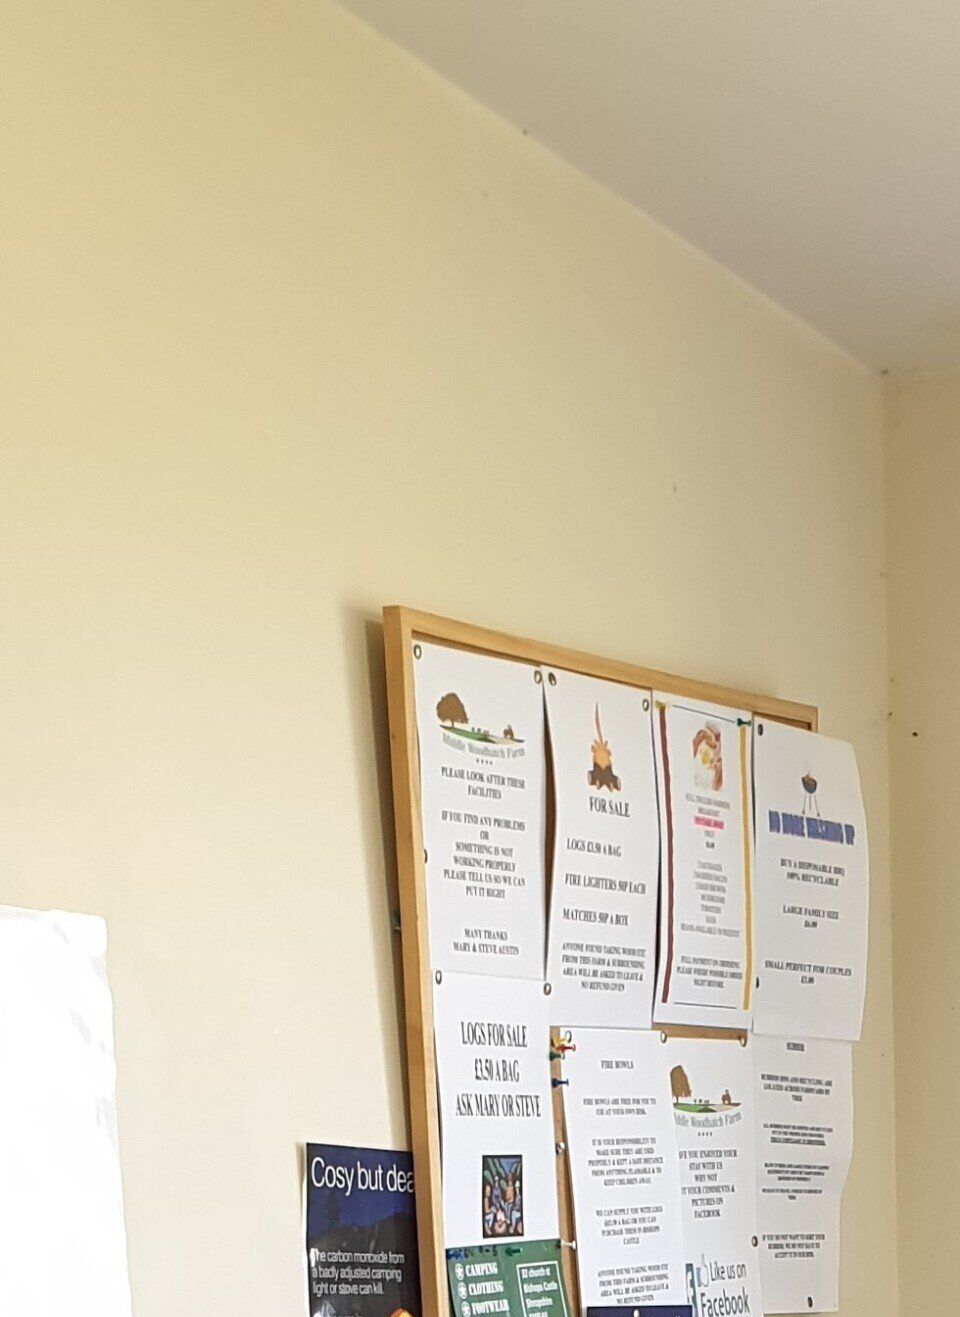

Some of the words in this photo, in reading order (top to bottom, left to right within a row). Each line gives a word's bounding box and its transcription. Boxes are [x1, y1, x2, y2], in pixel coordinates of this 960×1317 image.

[441, 766, 465, 780] PLEASE
[466, 770, 485, 782] LOOK
[486, 774, 505, 786] AFTER
[507, 777, 526, 789] THESE
[468, 785, 502, 799] FACILITIES
[589, 796, 608, 813] FOR
[609, 800, 630, 818] SALE
[441, 810, 449, 821] IF
[449, 812, 463, 822] YOU
[464, 813, 479, 825] FIND
[480, 816, 492, 826] ANY
[493, 818, 526, 831] PROBLEMS
[480, 831, 489, 840] OR
[455, 842, 493, 855] SOMETHING
[494, 846, 501, 856] IS
[501, 847, 514, 858] NOT
[567, 838, 585, 852] LOGS
[608, 844, 621, 858] BAG
[453, 856, 484, 868] WORKING
[485, 860, 516, 872] PROPERLY
[443, 869, 467, 881] PLEASE
[468, 871, 483, 882] TELL
[484, 873, 493, 883] US
[493, 874, 501, 884] SO
[502, 875, 512, 886] WE
[512, 877, 526, 887] CAN
[565, 873, 582, 886] FIRE
[583, 875, 617, 891] LIGHTERS
[629, 881, 646, 895] EACH
[466, 885, 478, 897] PUT
[478, 887, 485, 897] IT
[486, 888, 506, 899] RIGHT
[563, 908, 597, 922] MATCHES
[615, 914, 628, 926] BOX
[783, 905, 803, 915] LARGE
[804, 908, 825, 918] FAMILY
[464, 928, 482, 939] MANY
[484, 930, 508, 941] THANKS
[453, 942, 470, 952] MARY
[478, 944, 497, 954] STEVE
[765, 960, 784, 970] SMALL
[785, 962, 812, 972] PERFECT
[460, 1021, 486, 1046] LOGS
[487, 1023, 506, 1046] FOR
[506, 1024, 528, 1048] SALE
[474, 1058, 494, 1081] £3.50
[495, 1060, 501, 1081] A
[501, 1059, 520, 1082] BAG
[601, 1060, 614, 1069] FIRE
[456, 1093, 473, 1116] ASK
[474, 1093, 500, 1117] MARY
[501, 1094, 515, 1117] OR
[515, 1095, 541, 1117] STEVE
[688, 1150, 699, 1159] YOU
[699, 1149, 722, 1159] ENJOYED
[723, 1149, 738, 1158] YOUR
[689, 1162, 701, 1171] STAY
[702, 1161, 716, 1170] WITH
[716, 1161, 723, 1170] US
[311, 1156, 355, 1196] Cosy
[357, 1160, 384, 1192] but
[386, 1163, 414, 1193] dea
[706, 1173, 718, 1182] NOT
[691, 1197, 716, 1207] PICTURES
[694, 1209, 722, 1219] FACEBOOK
[327, 1251, 353, 1263] carbon
[354, 1251, 388, 1263] monoxide
[388, 1251, 405, 1264] from
[318, 1266, 340, 1281] badly
[340, 1267, 371, 1281] adjusted
[371, 1269, 402, 1283] camping
[465, 1262, 498, 1277] CAMPING
[709, 1260, 726, 1282] Like
[726, 1264, 736, 1280] us
[736, 1263, 747, 1279] on
[312, 1281, 329, 1297] light
[329, 1284, 337, 1294] or
[338, 1283, 358, 1295] stove
[359, 1284, 373, 1295] can
[468, 1280, 504, 1296] CLOTHING
[471, 1299, 509, 1315] FOOTWEAR
